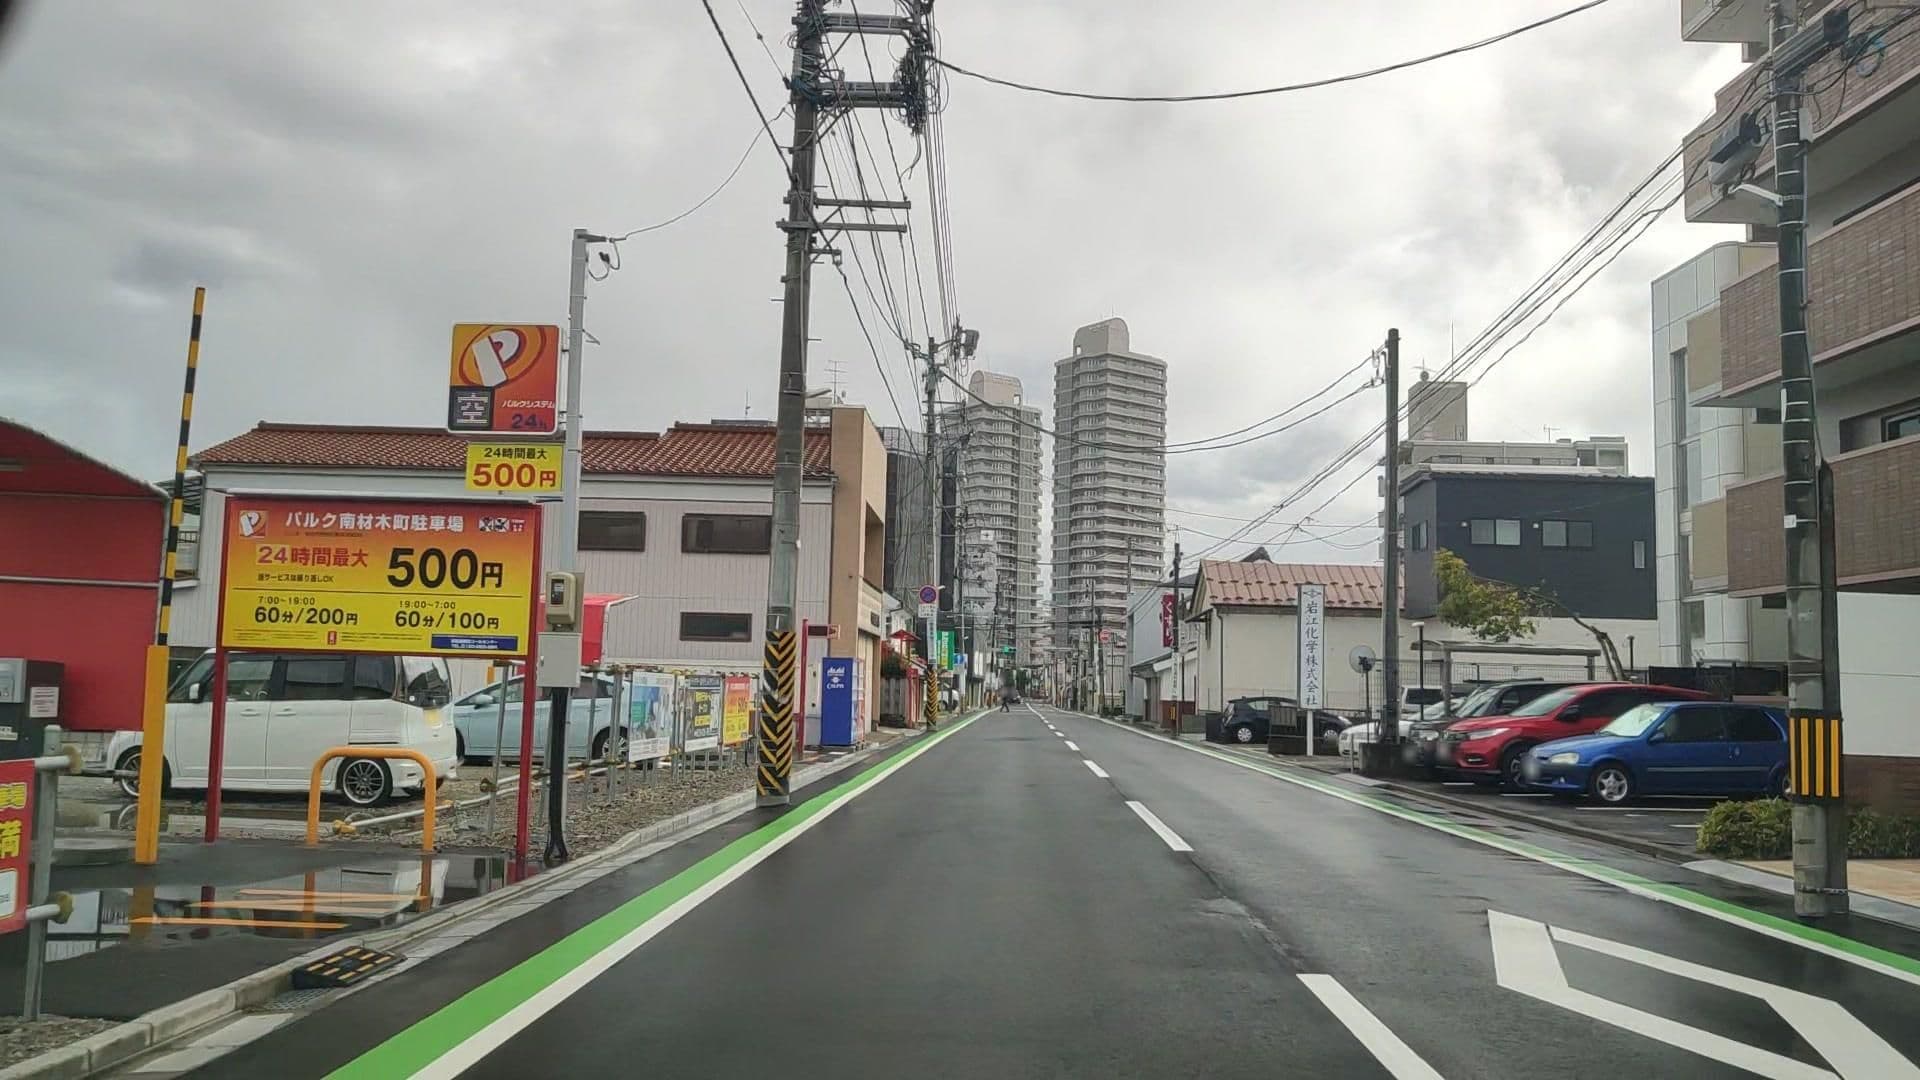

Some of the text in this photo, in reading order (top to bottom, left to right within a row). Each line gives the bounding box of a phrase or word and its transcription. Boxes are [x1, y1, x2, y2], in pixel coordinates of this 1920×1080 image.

[457, 392, 489, 424] 空
[484, 447, 548, 460] 24時間最大
[473, 462, 557, 488] 500円
[285, 511, 464, 532] パルク南材木町駐車場
[257, 545, 369, 567] 24時間最大
[387, 547, 504, 589] 500円
[254, 606, 359, 626] 60分/200円
[395, 611, 499, 630] 60分/100円
[1304, 600, 1320, 706] 岩江化学株式会社
